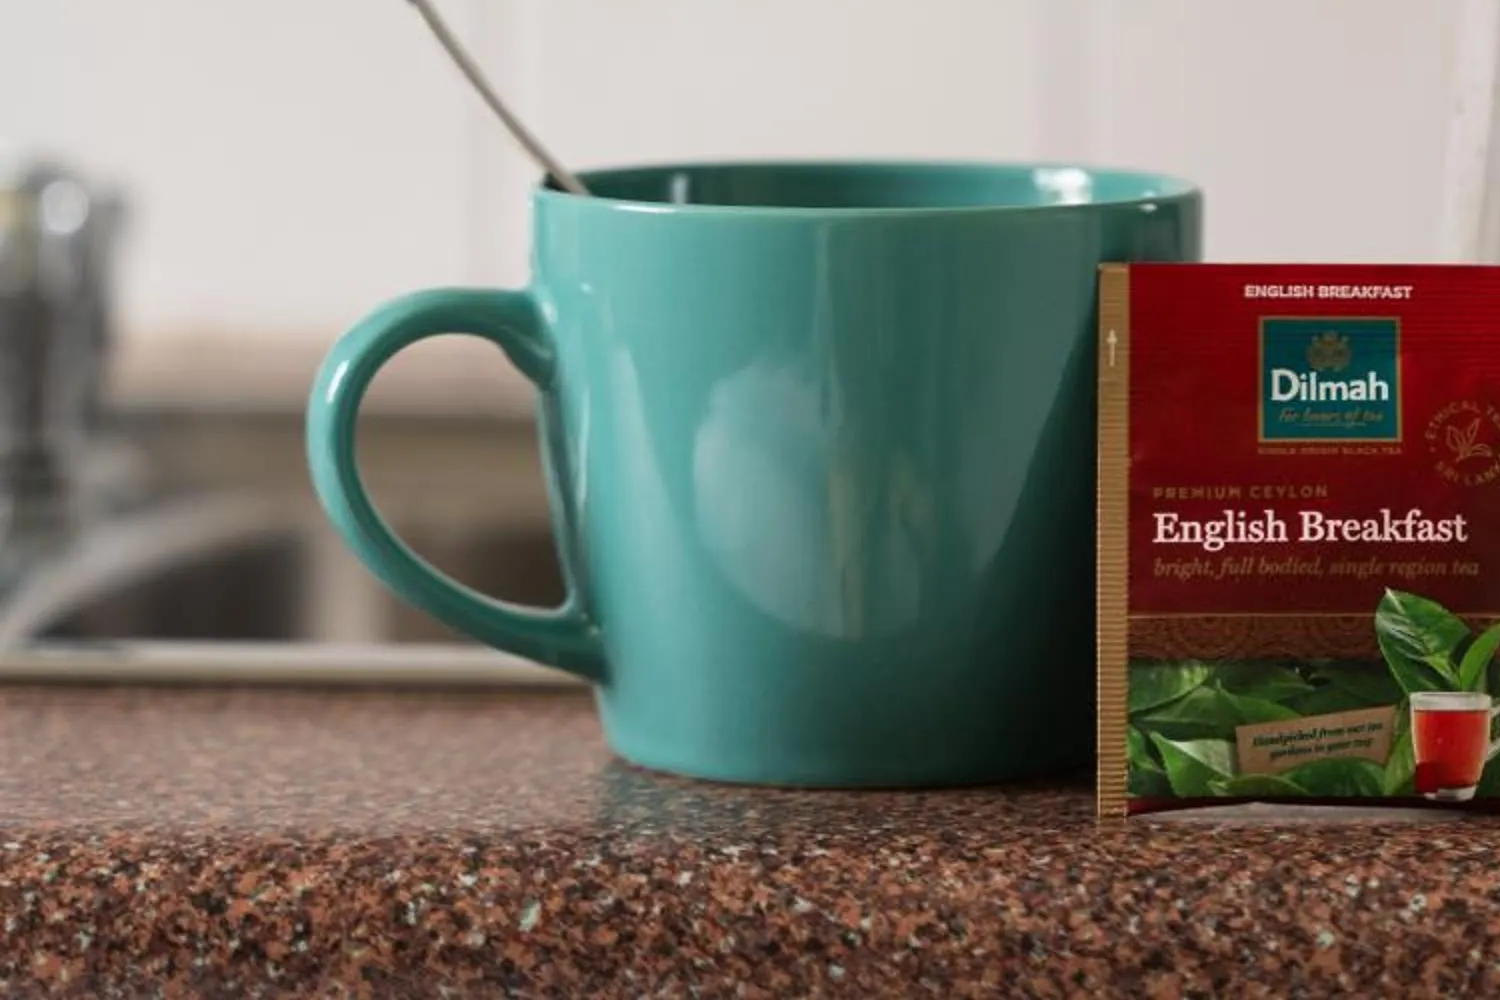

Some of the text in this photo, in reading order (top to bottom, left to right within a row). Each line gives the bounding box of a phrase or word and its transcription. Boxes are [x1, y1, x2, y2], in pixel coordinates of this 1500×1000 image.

[1244, 284, 1413, 299] ENGLISH BREAKFAST
[1271, 368, 1389, 401] Dilmah
[1153, 484, 1328, 499] PREMIUM CEYLON
[1152, 508, 1468, 551] English Breakfast
[1153, 556, 1480, 579] bright, full bodied, single region tea
